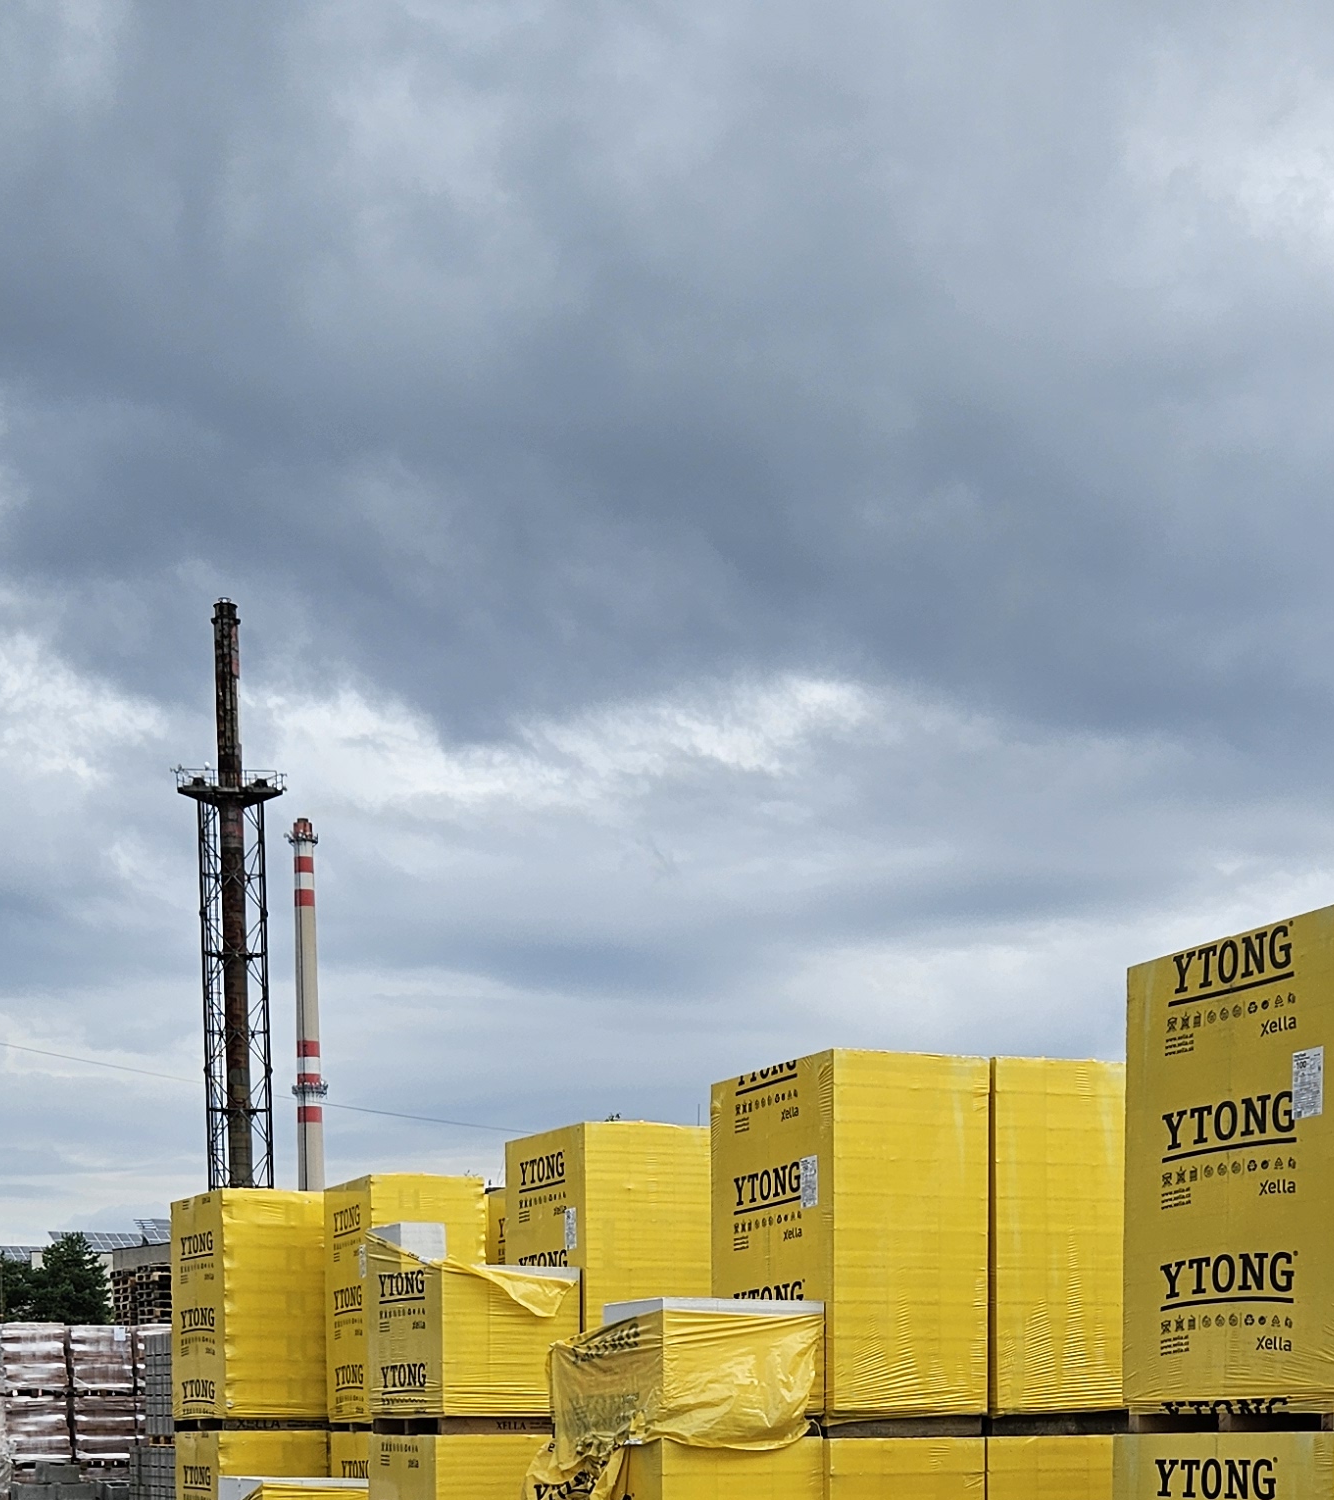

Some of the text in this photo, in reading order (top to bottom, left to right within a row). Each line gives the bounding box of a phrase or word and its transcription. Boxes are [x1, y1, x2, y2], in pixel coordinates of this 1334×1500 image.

[1173, 925, 1293, 994] YTONG
[1260, 1016, 1297, 1037] Xella
[1162, 1091, 1296, 1150] YTONG
[520, 1151, 565, 1186] YTONG
[733, 1161, 801, 1206] YTONG
[1259, 1179, 1296, 1196] Xella
[333, 1204, 361, 1232] YTONG
[180, 1230, 214, 1256] YTONG
[378, 1269, 425, 1298] YTONG
[1160, 1251, 1295, 1299] YTONG
[334, 1285, 362, 1310] YTONG
[181, 1307, 214, 1329] YTONG
[1256, 1336, 1292, 1352] Xella
[335, 1364, 364, 1387] YTONG
[380, 1362, 426, 1388] YTONG
[181, 1379, 215, 1400] YTONG
[496, 1421, 527, 1430] XELLA
[183, 1465, 211, 1486] YTONG
[341, 1460, 369, 1479] YTON
[1155, 1458, 1277, 1500] YTONG
